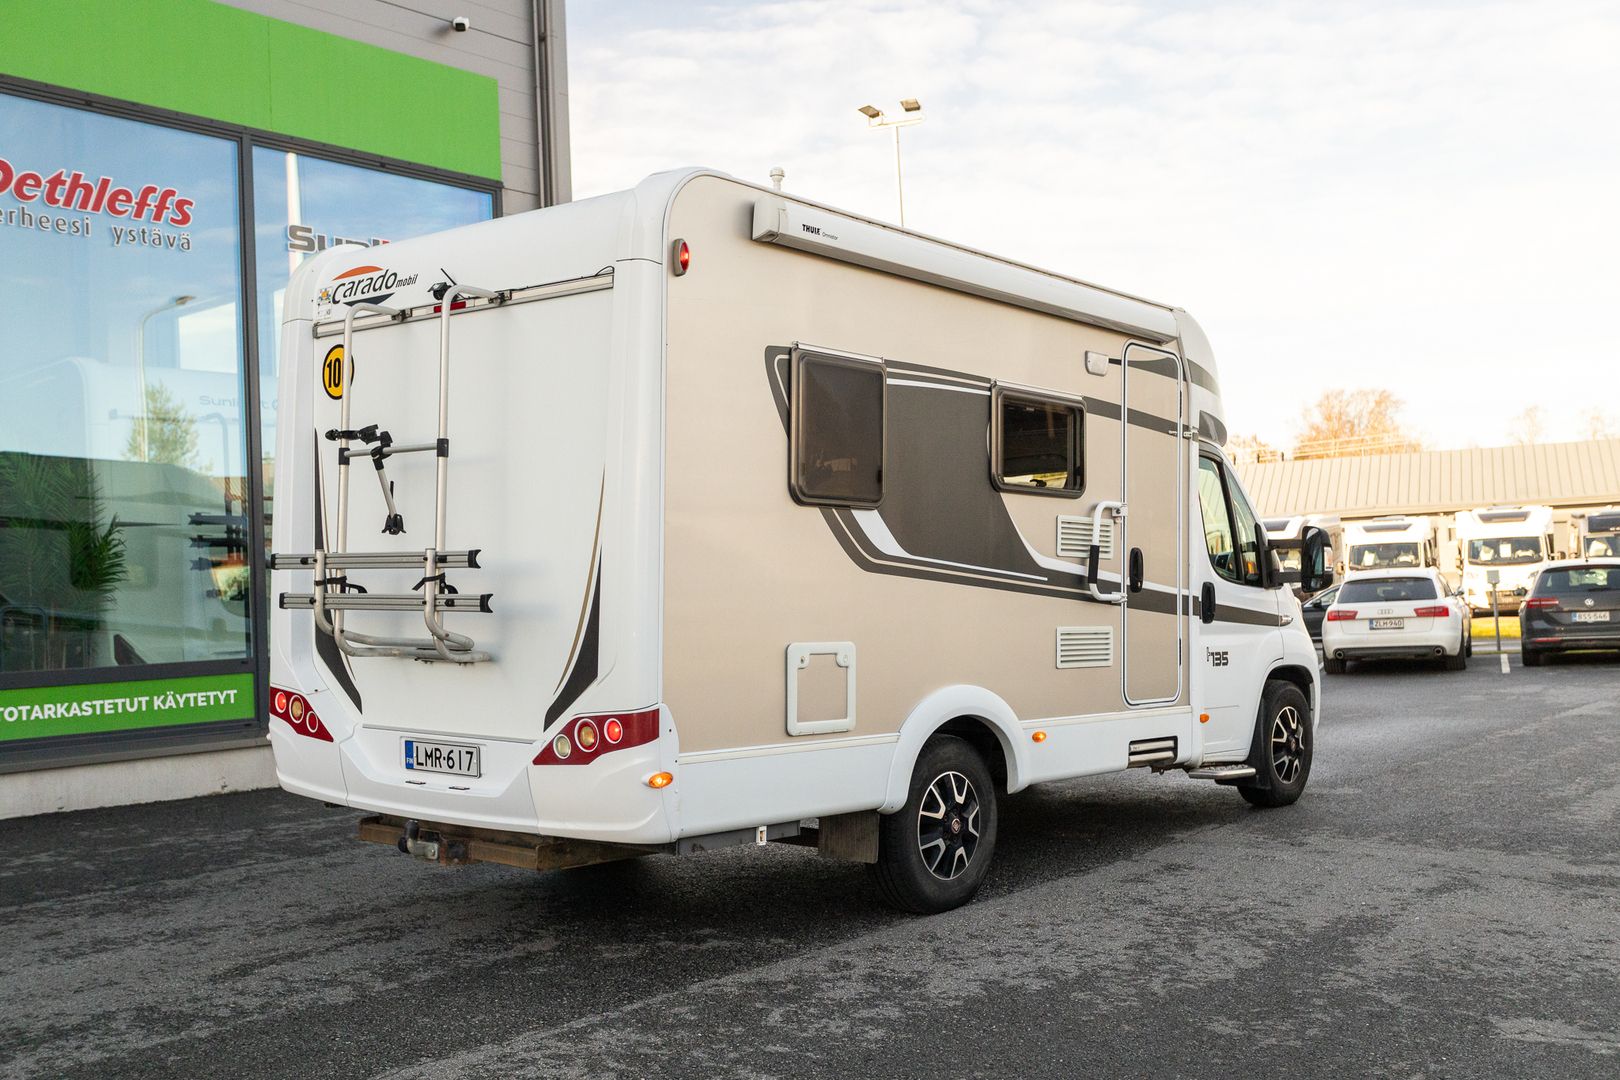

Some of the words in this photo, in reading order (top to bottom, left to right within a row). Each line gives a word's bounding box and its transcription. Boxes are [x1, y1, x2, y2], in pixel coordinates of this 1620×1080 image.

[0, 206, 91, 236] rheesi
[113, 225, 193, 251] ystävä
[802, 223, 821, 236] THULE
[395, 273, 419, 288] mobil
[153, 689, 238, 711] KÄYTETYT
[415, 745, 474, 772] LMR-617
